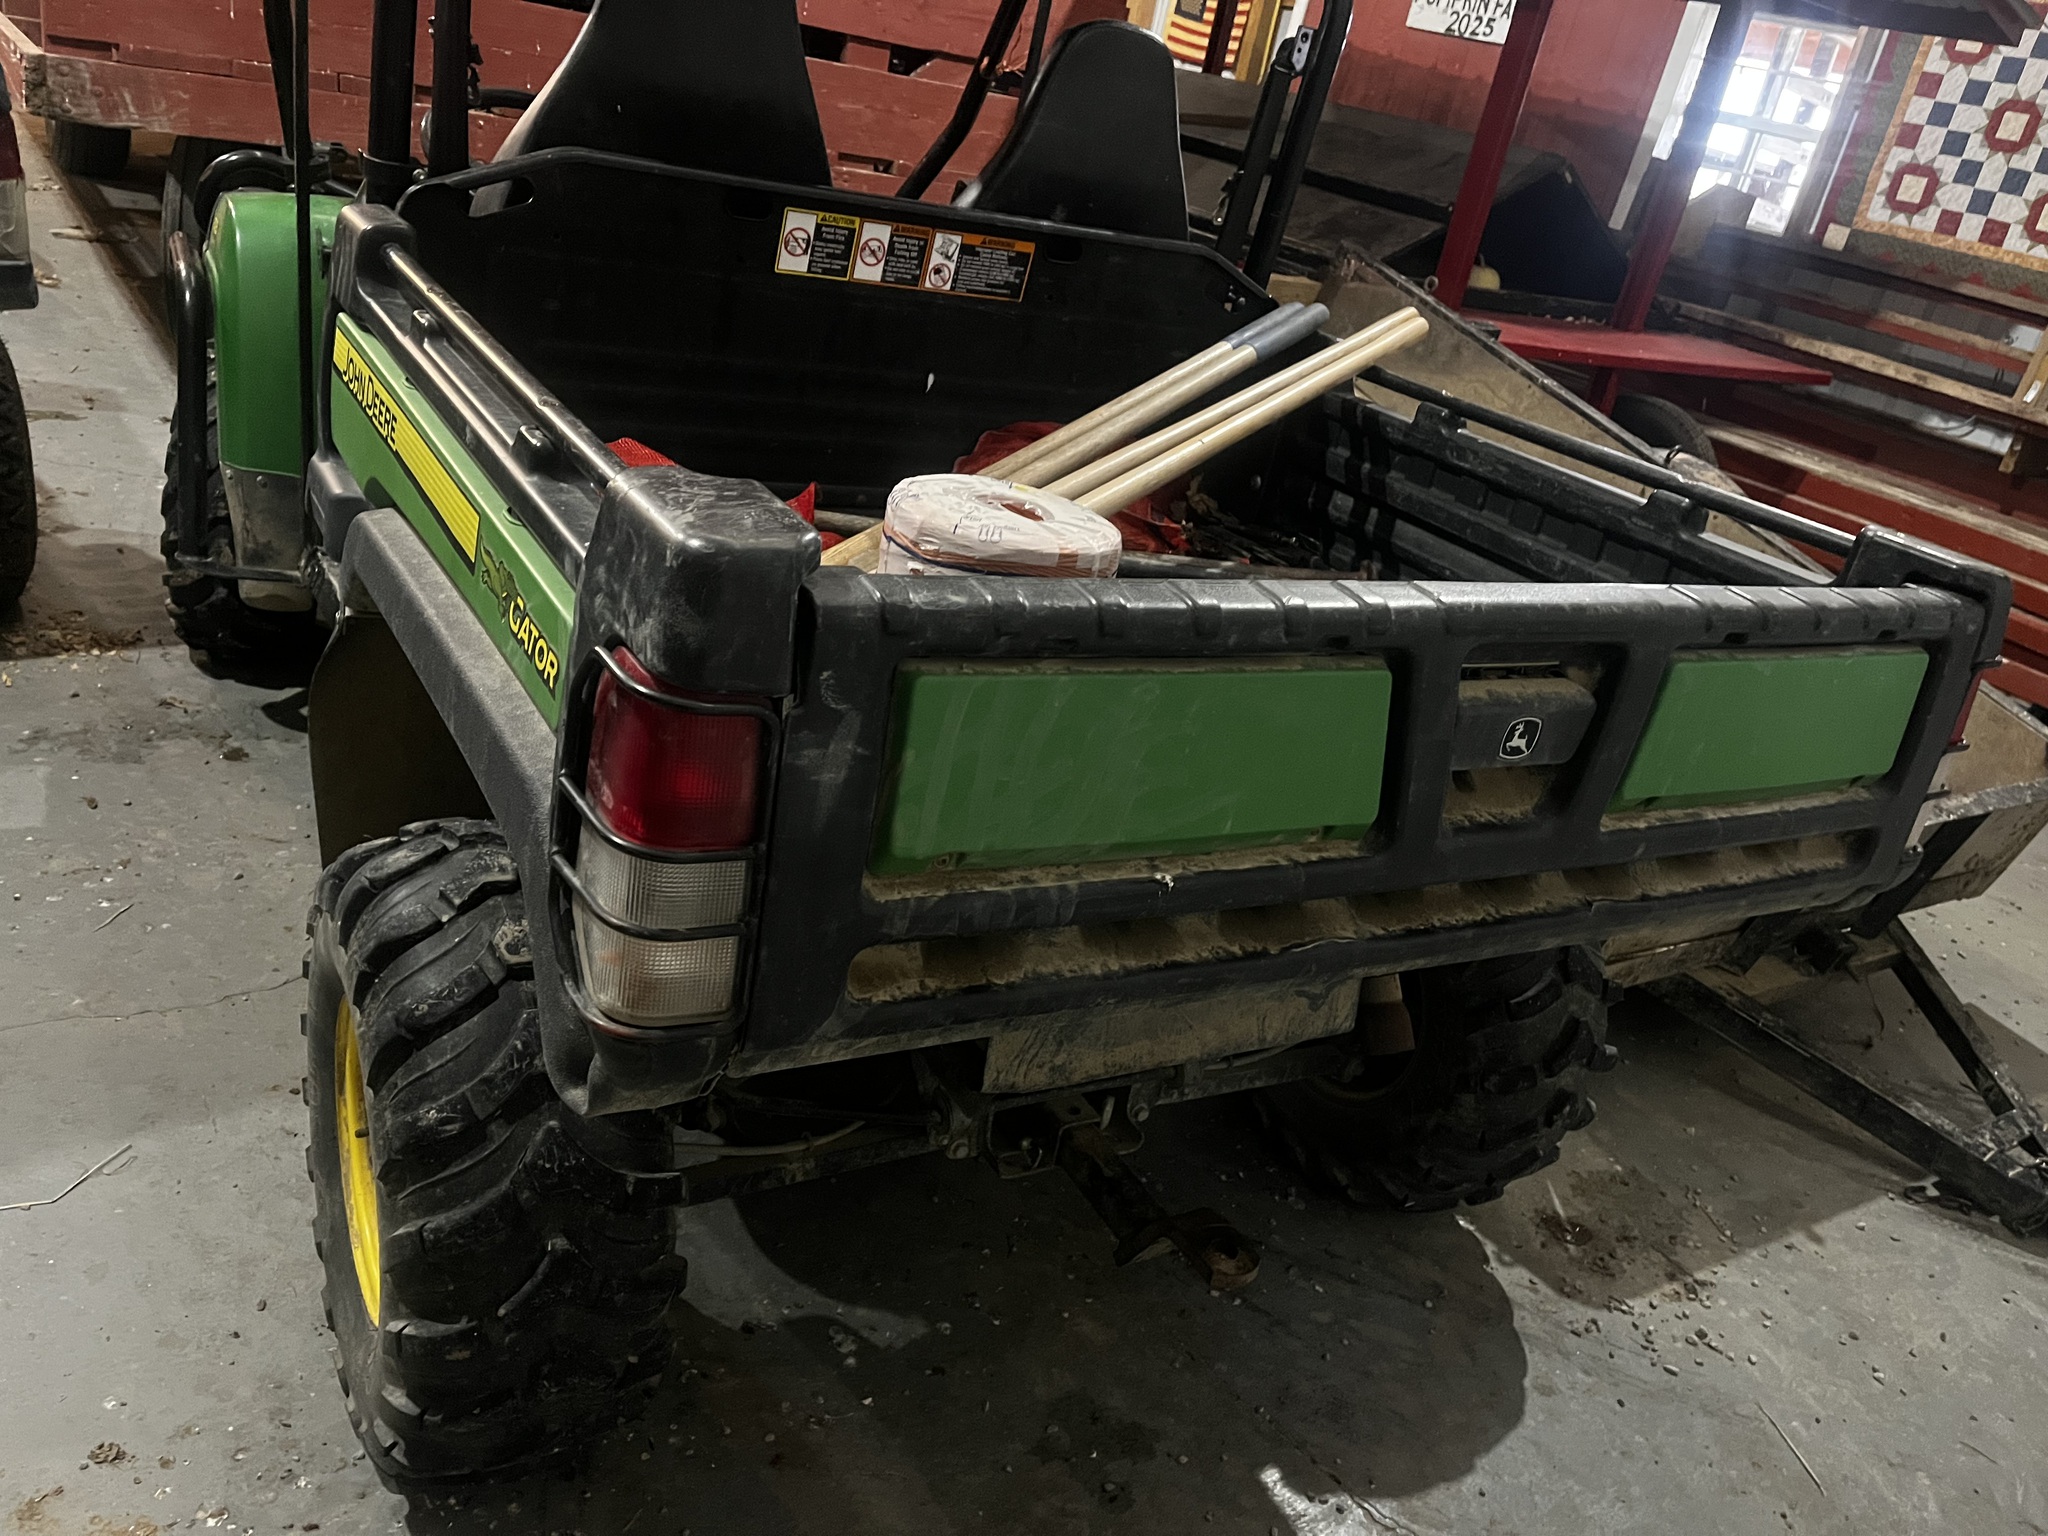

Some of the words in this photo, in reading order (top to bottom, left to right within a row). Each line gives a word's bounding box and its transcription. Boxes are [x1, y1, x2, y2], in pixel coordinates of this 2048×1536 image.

[1444, 11, 1496, 38] 2025
[342, 347, 367, 408] JOHN
[365, 374, 398, 451] DEERE
[508, 595, 559, 690] GATOR
